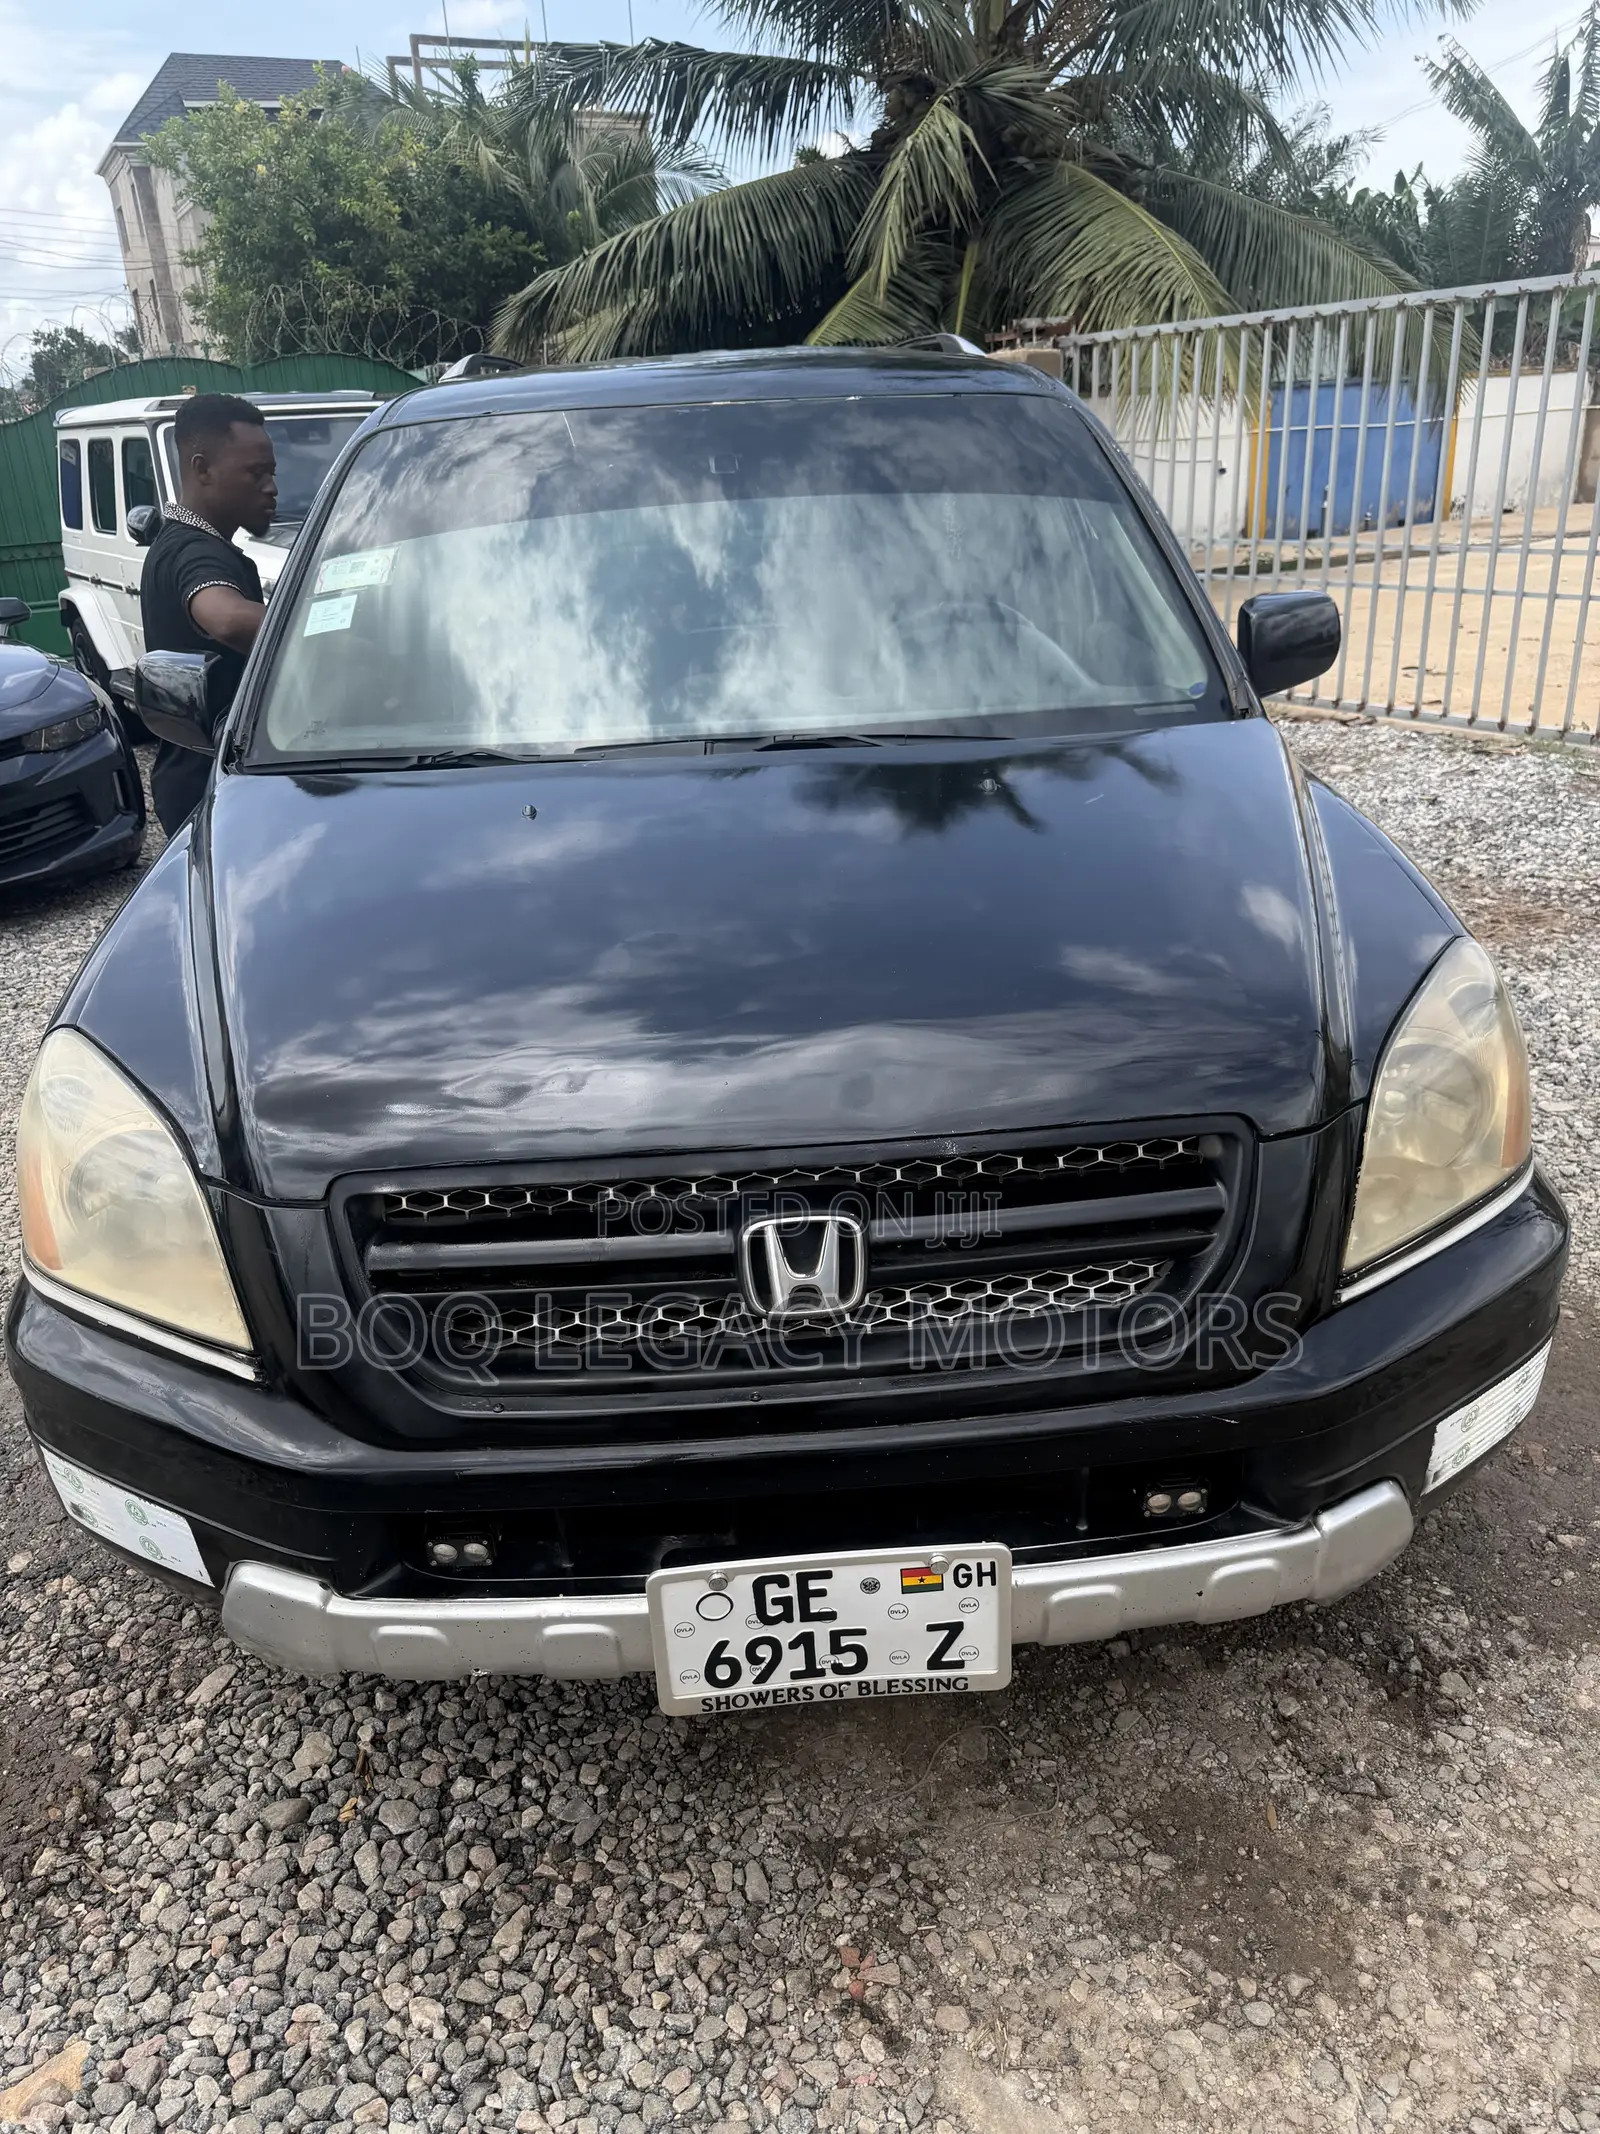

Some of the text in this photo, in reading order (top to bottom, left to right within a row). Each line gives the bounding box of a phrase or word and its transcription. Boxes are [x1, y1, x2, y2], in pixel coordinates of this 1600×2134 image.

[953, 1561, 997, 1588] GH
[752, 1570, 837, 1625] GE
[704, 1621, 965, 1689] 6915 Z
[701, 1677, 969, 1712] SHOWERS OF BLESSING
